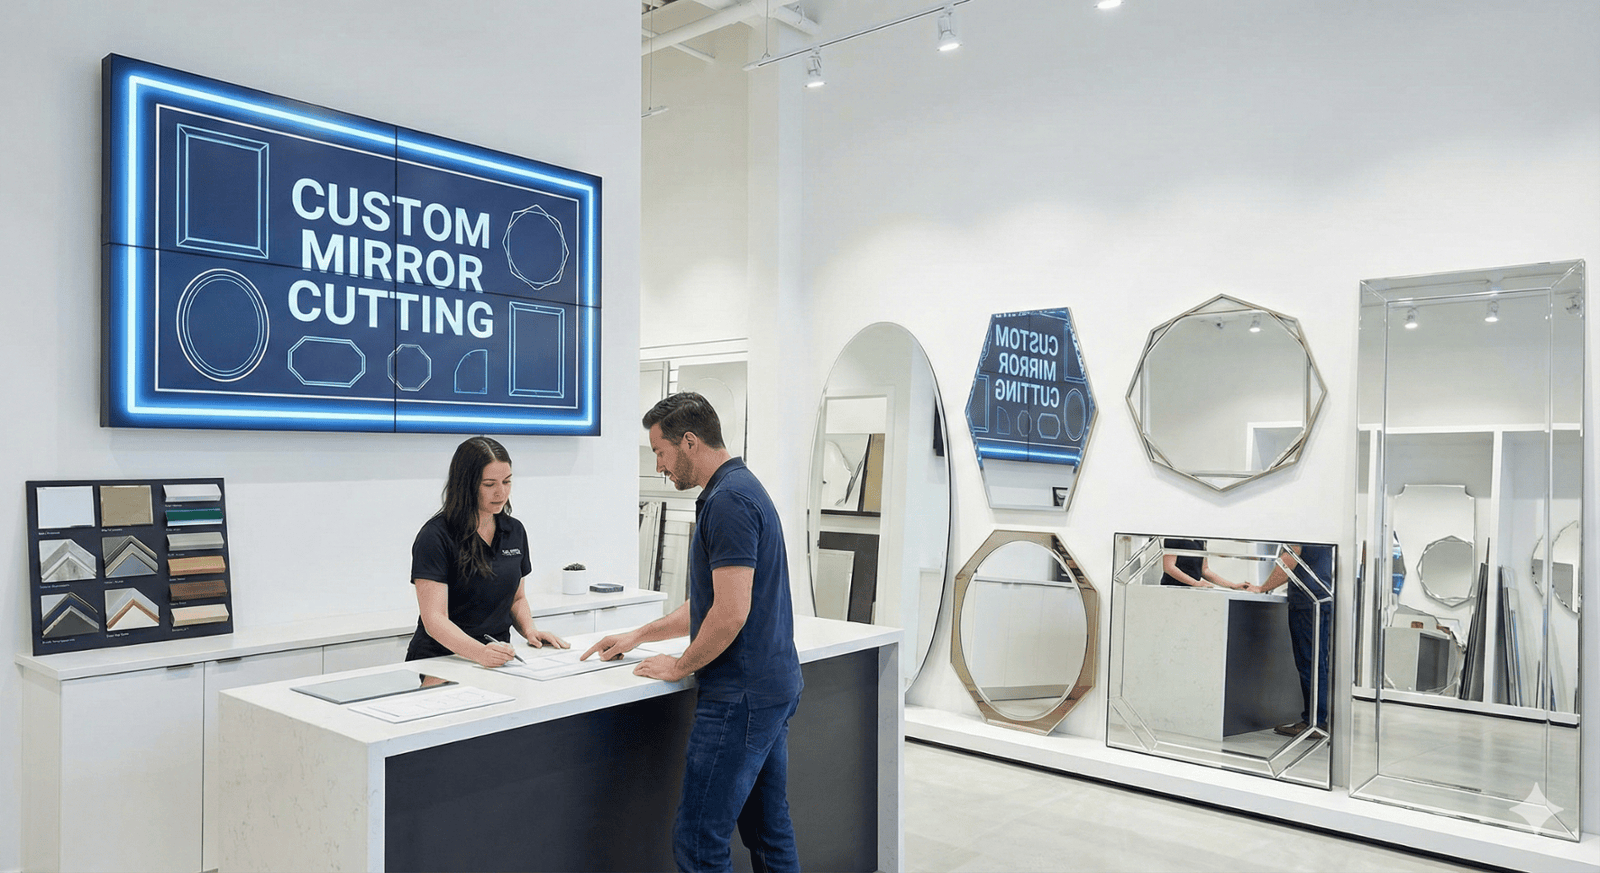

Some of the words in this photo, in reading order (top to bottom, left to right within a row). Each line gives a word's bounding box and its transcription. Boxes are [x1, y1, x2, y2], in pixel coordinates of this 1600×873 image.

[292, 178, 490, 249] CUSTOM
[302, 229, 483, 294] MIRROR
[288, 280, 494, 338] CUTTING
